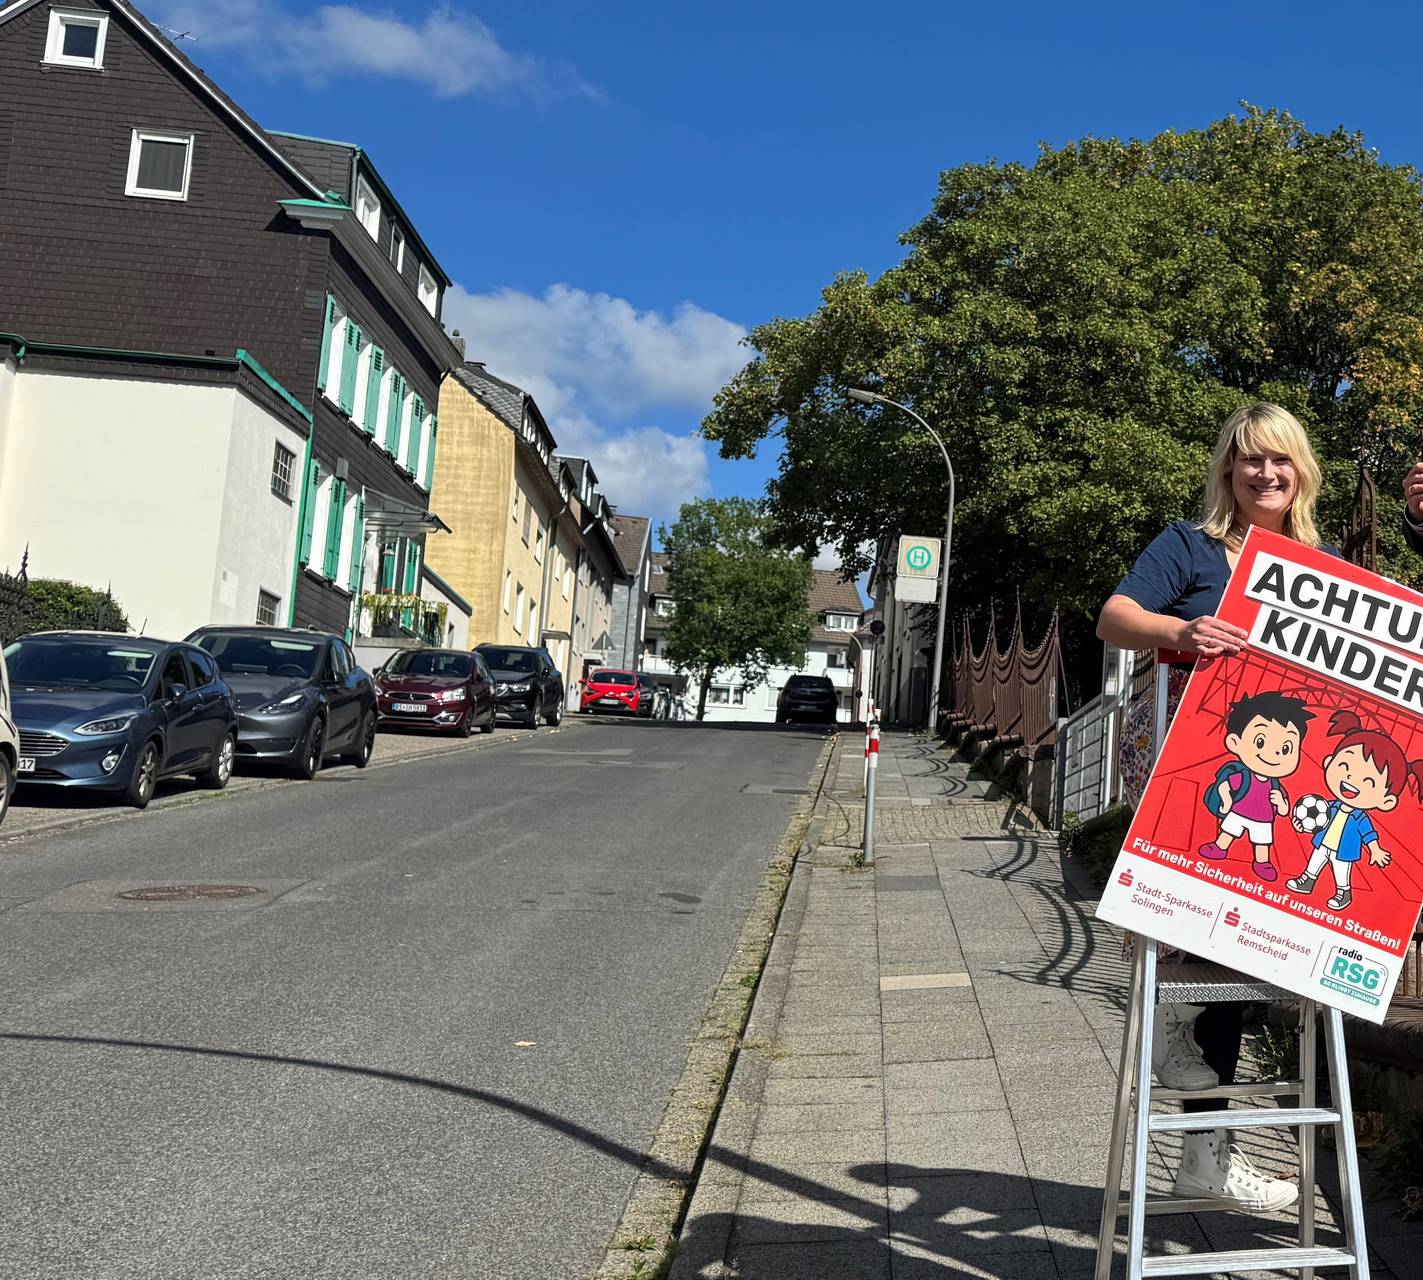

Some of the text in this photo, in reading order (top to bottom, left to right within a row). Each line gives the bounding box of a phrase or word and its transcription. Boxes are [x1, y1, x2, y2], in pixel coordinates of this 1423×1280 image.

[1130, 894, 1174, 917] Solingen
[1132, 837, 1402, 950] Für mehr Sicherheit auf unseren Straßen!
[1135, 882, 1213, 918] Stadt-Sparkasse
[1237, 934, 1288, 961] Remscheid
[1241, 922, 1312, 956] Stadtsparkasse
[1338, 947, 1363, 961] radio
[1331, 956, 1380, 990] RSG
